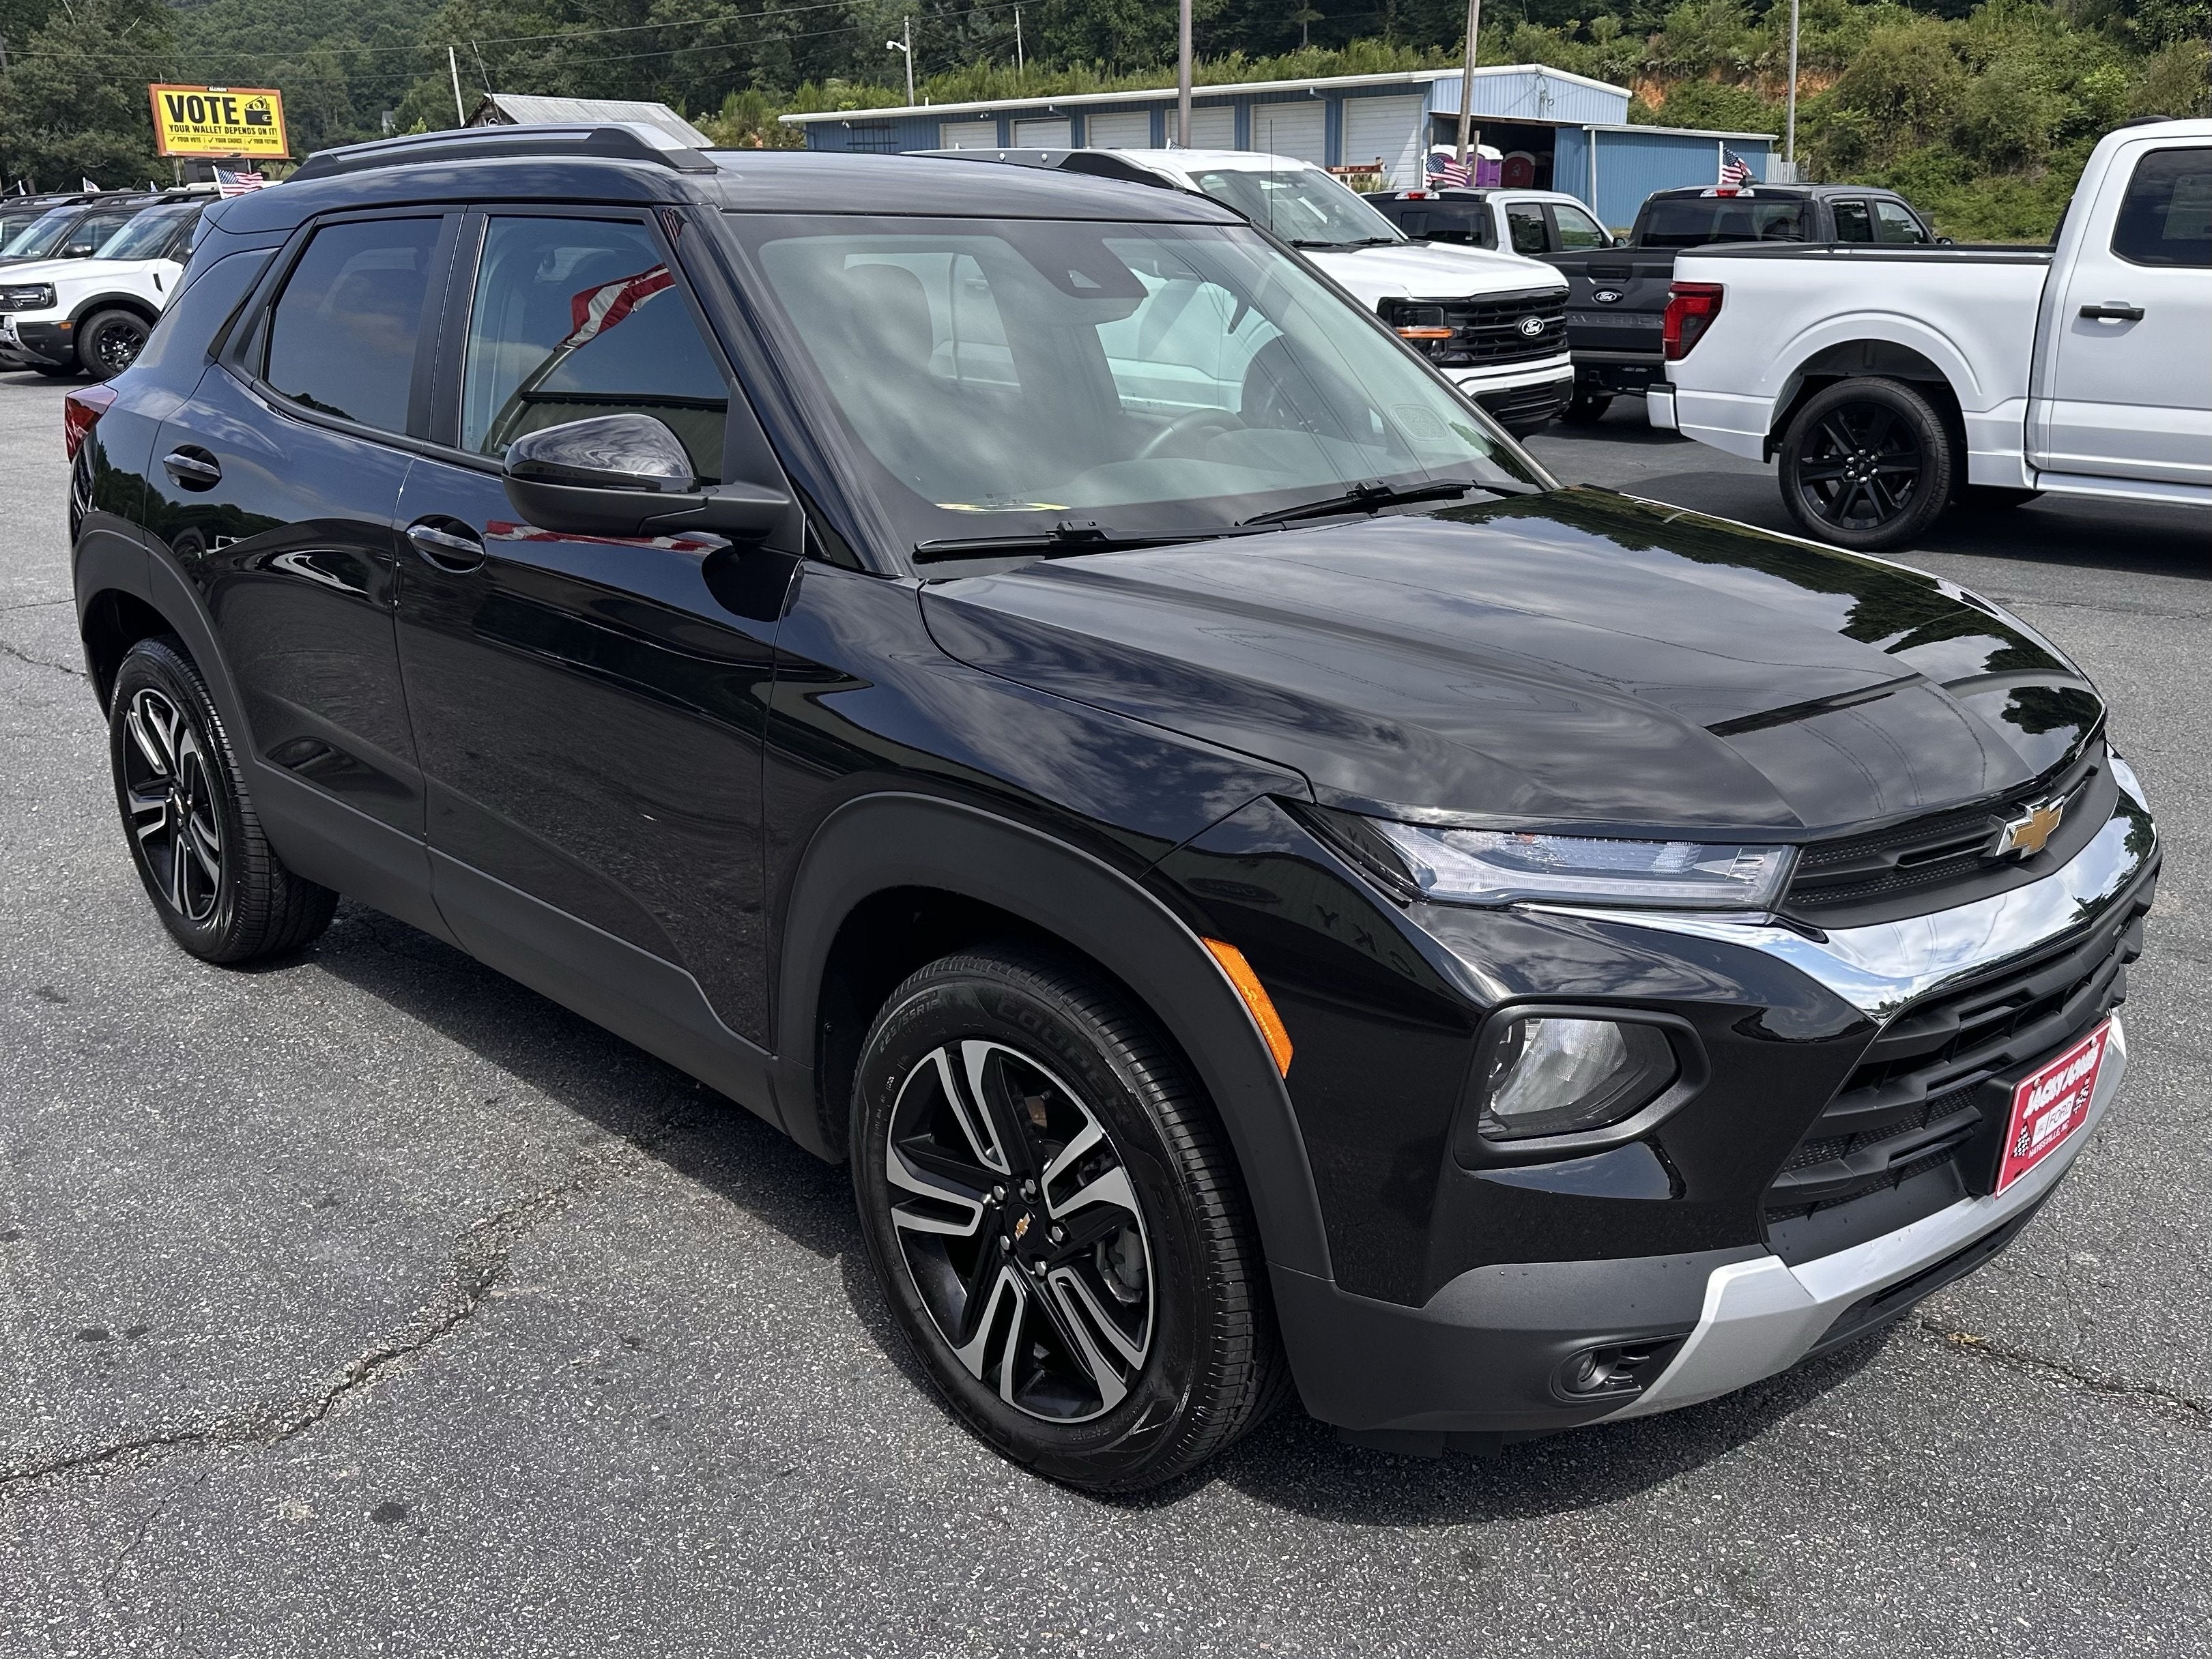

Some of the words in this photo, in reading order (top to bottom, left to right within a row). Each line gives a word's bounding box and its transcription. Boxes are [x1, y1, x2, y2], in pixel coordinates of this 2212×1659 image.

[164, 94, 240, 125] VOTE
[169, 125, 190, 133] YOUR
[192, 126, 222, 134] WALLET
[225, 126, 256, 135] DEPENDS
[1596, 292, 1616, 301] Ford
[1569, 315, 1664, 326] AVERICK
[1524, 320, 1542, 334] Ford
[2049, 1100, 2072, 1127] FORD
